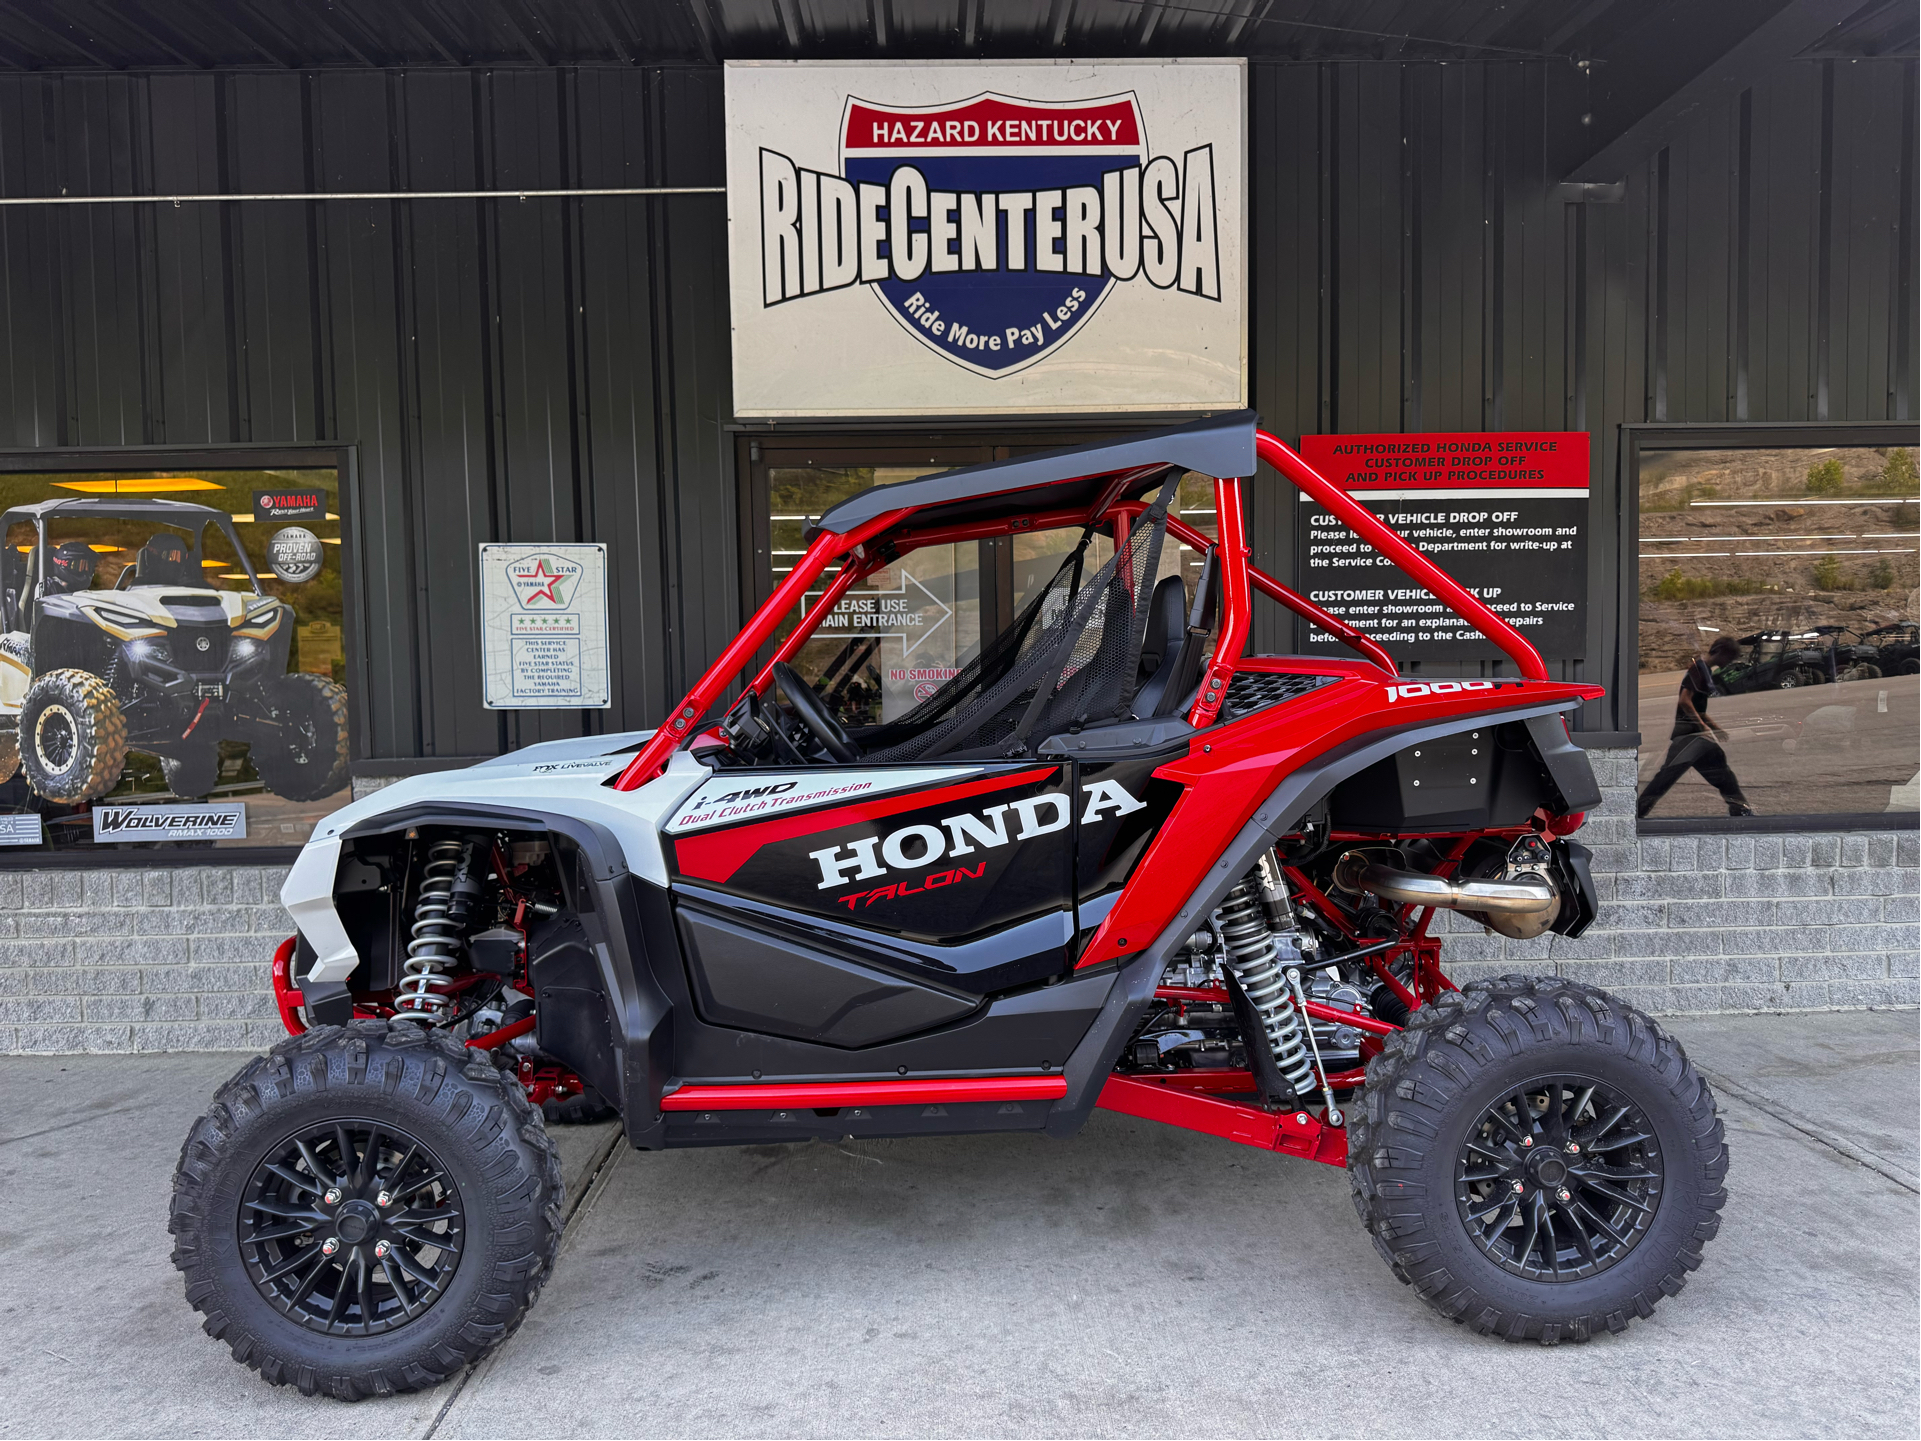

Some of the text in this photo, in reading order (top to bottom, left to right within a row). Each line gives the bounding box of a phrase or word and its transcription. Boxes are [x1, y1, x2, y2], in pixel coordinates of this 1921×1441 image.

[872, 119, 1122, 143] HAZARD KENTUCKY
[904, 286, 1087, 350] Ride More Pay Less
[1333, 441, 1558, 455] AUTHORIZED HONDA SERVICE
[1365, 455, 1526, 468] CUSTOMER DROP OFF
[1345, 469, 1545, 483] AND PICK UP PROCEDURES
[273, 495, 318, 507] YAMAHA
[1310, 511, 1519, 525] CUSR VEHICLE DROP OFF
[1310, 530, 1346, 539] Please
[1412, 527, 1457, 538] vehicle,
[1459, 528, 1490, 537] enter
[1492, 527, 1553, 536] showroom
[1555, 526, 1577, 535] and
[273, 543, 312, 554] PROVEN
[1310, 543, 1357, 555] proceed
[1359, 544, 1373, 552] to
[1419, 542, 1487, 553] Department
[1489, 541, 1507, 550] for
[1510, 541, 1558, 551] write-up
[1560, 540, 1573, 549] at
[278, 552, 317, 562] OFF-ROAD
[1310, 558, 1329, 567] the
[1332, 557, 1373, 567] Service
[1310, 590, 1384, 601] CUSTOMER
[1387, 588, 1438, 600] VEHIC
[1483, 588, 1502, 598] UP
[833, 599, 908, 613] LEASE USE
[1348, 605, 1380, 614] enter
[1382, 604, 1443, 613] showroom
[1520, 602, 1532, 611] to
[1535, 601, 1575, 611] Service
[853, 613, 924, 627] ENTRANCE
[1381, 618, 1399, 627] for
[1401, 619, 1416, 627] an
[1419, 618, 1470, 628] explana
[1310, 633, 1339, 642] befo
[1418, 632, 1431, 640] to
[1433, 631, 1453, 640] the
[889, 669, 906, 681] NO
[692, 781, 799, 811] i-4WD
[678, 782, 873, 826] Dual Clutch Transmission
[99, 807, 241, 834] WOLVERINE
[0, 824, 14, 834] SA
[168, 828, 233, 837] RMAX 1000
[809, 779, 1147, 890] HONDA
[838, 862, 987, 910] TALON
[210, 1148, 258, 1269] KENDA
[1620, 1179, 1694, 1286] KENDA
